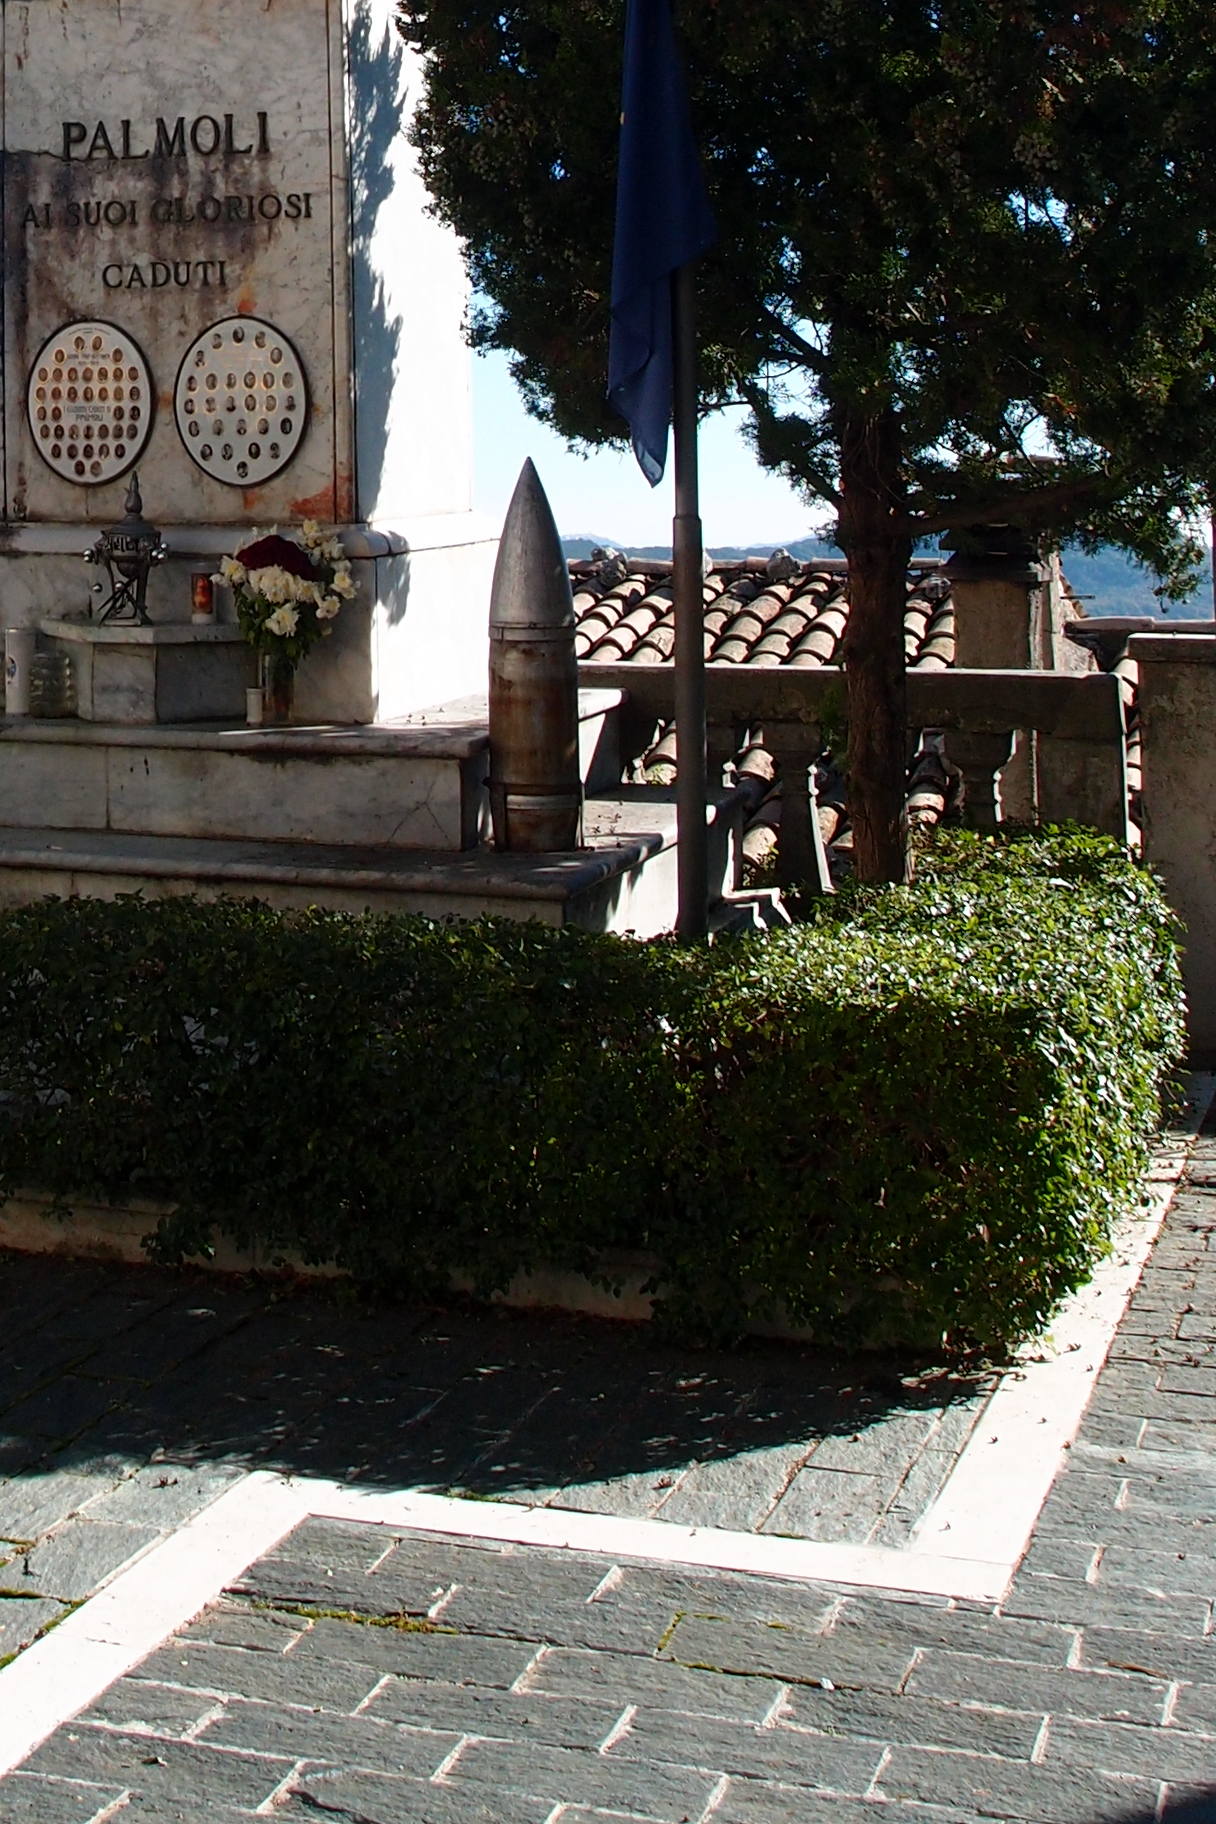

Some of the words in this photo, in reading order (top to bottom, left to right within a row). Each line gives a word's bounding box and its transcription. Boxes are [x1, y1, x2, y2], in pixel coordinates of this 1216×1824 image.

[61, 112, 270, 162] PALMOLI
[22, 202, 52, 228] AI
[64, 200, 138, 226] SUOI
[149, 193, 312, 223] GLORIOSI
[101, 260, 227, 289] CADUTI
